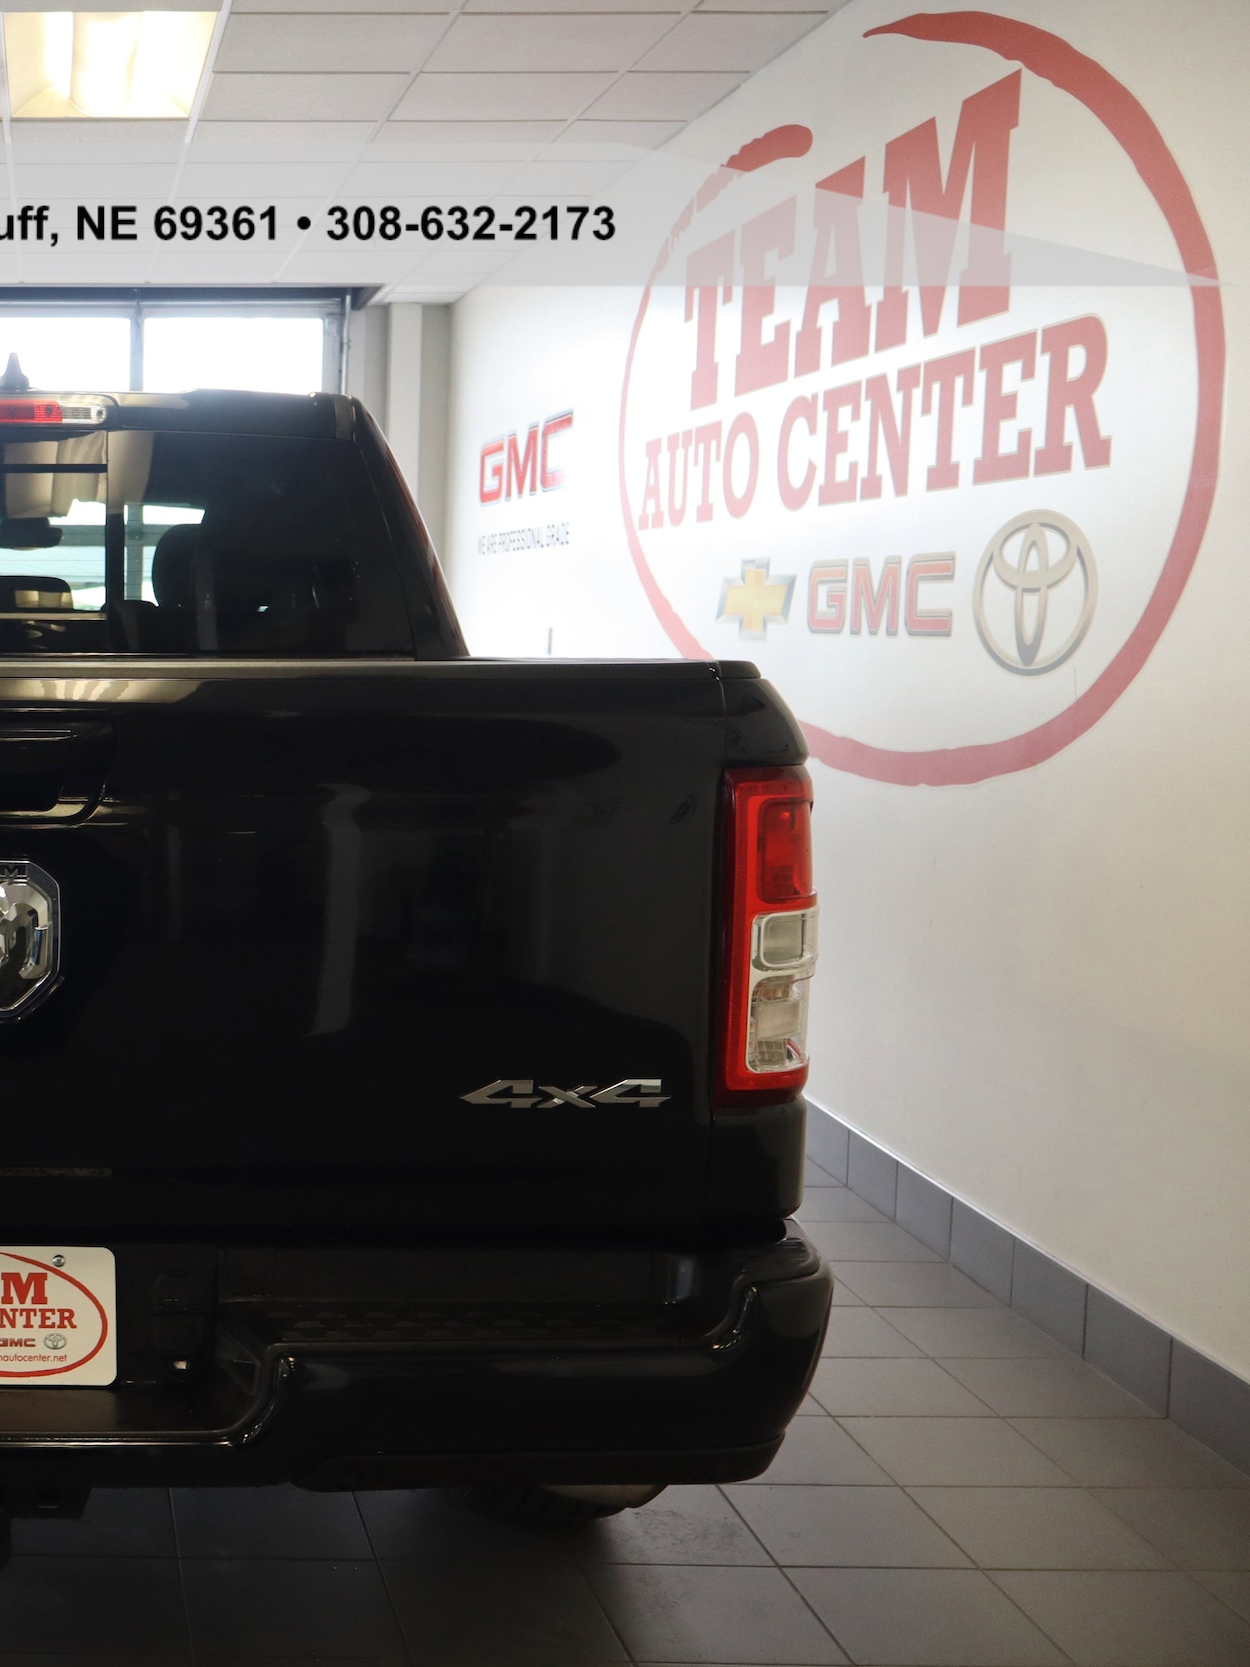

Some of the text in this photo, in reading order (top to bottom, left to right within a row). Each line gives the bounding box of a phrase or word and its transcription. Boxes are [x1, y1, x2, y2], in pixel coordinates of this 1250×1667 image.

[683, 68, 1022, 412] TEAM
[479, 408, 574, 507] GMC
[638, 313, 1113, 531] AUTO CENTER
[806, 550, 957, 638] GMC
[459, 1078, 671, 1109] 4x4
